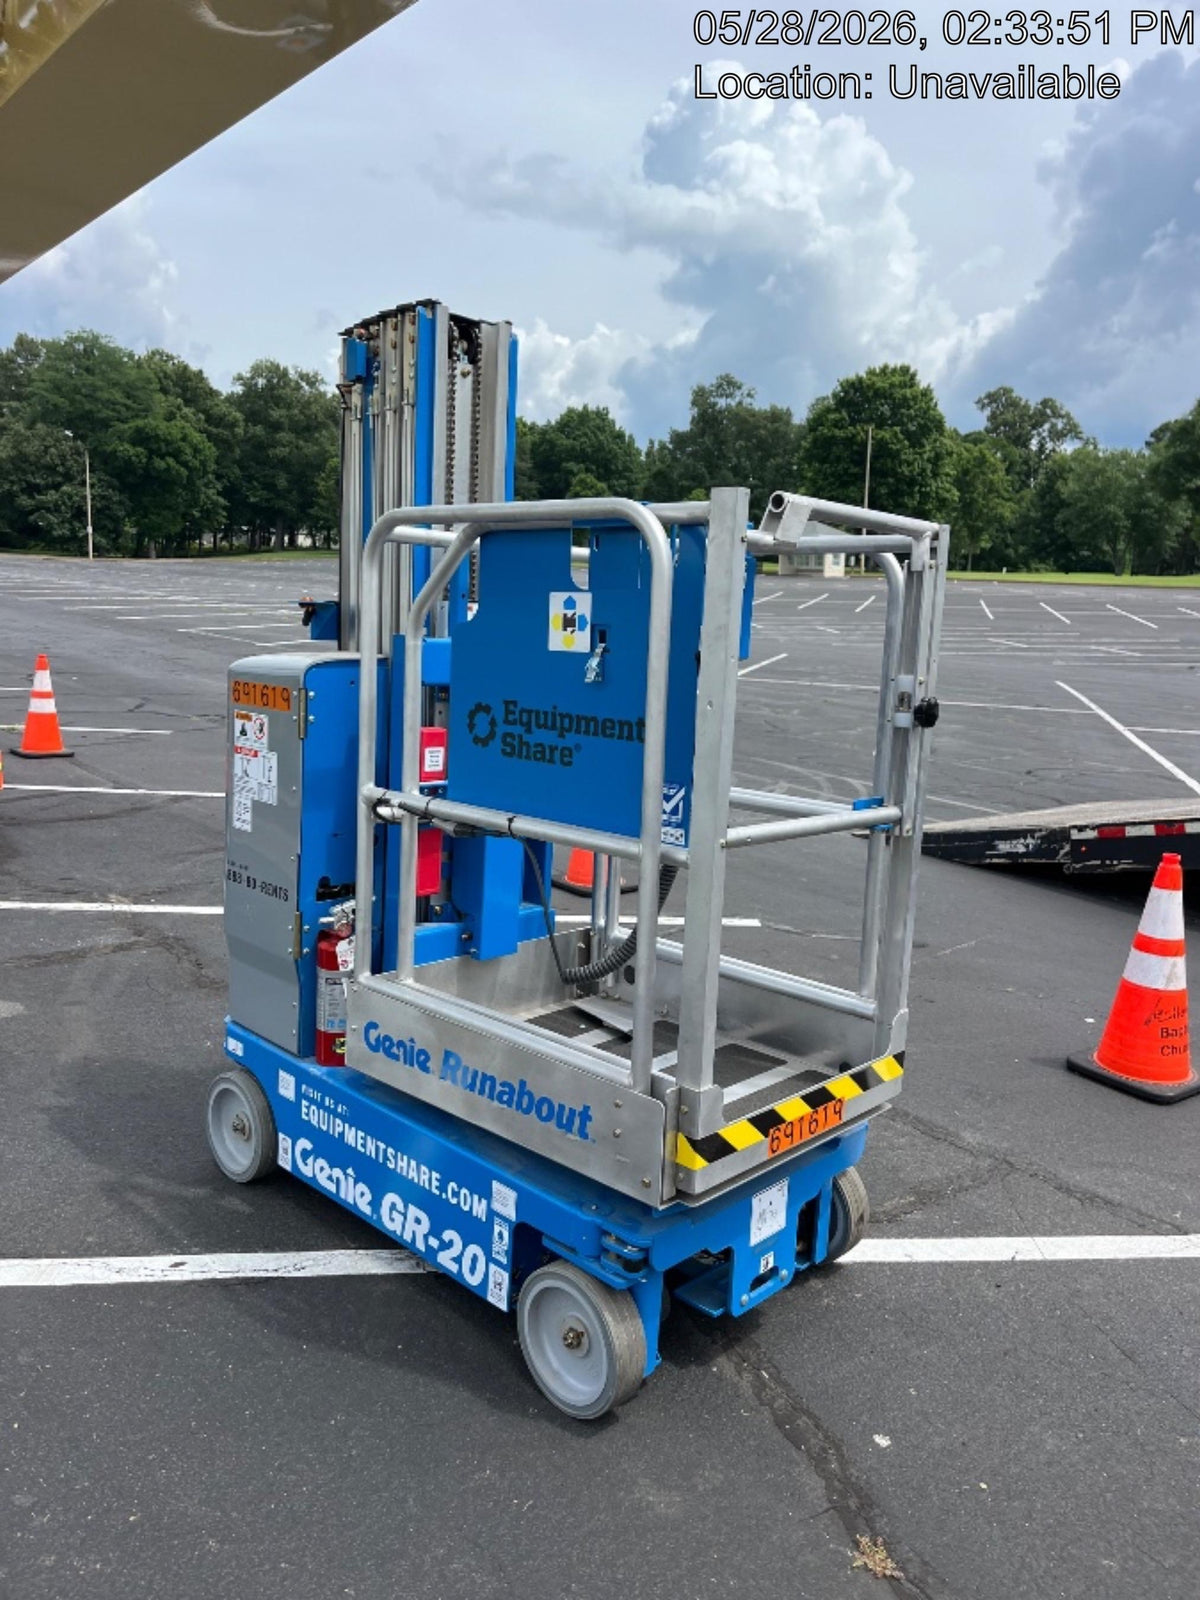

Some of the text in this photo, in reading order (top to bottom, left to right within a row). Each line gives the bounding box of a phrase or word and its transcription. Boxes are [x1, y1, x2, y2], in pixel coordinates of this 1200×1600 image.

[232, 680, 291, 710] 691619
[503, 700, 646, 743] Equipment
[363, 1021, 593, 1140] Genie Runabout
[301, 1099, 488, 1222] EQUIPMENTSHARE.COM
[770, 1098, 843, 1154] 691619
[294, 1137, 373, 1213] Genie
[380, 1193, 487, 1287] GR-20
